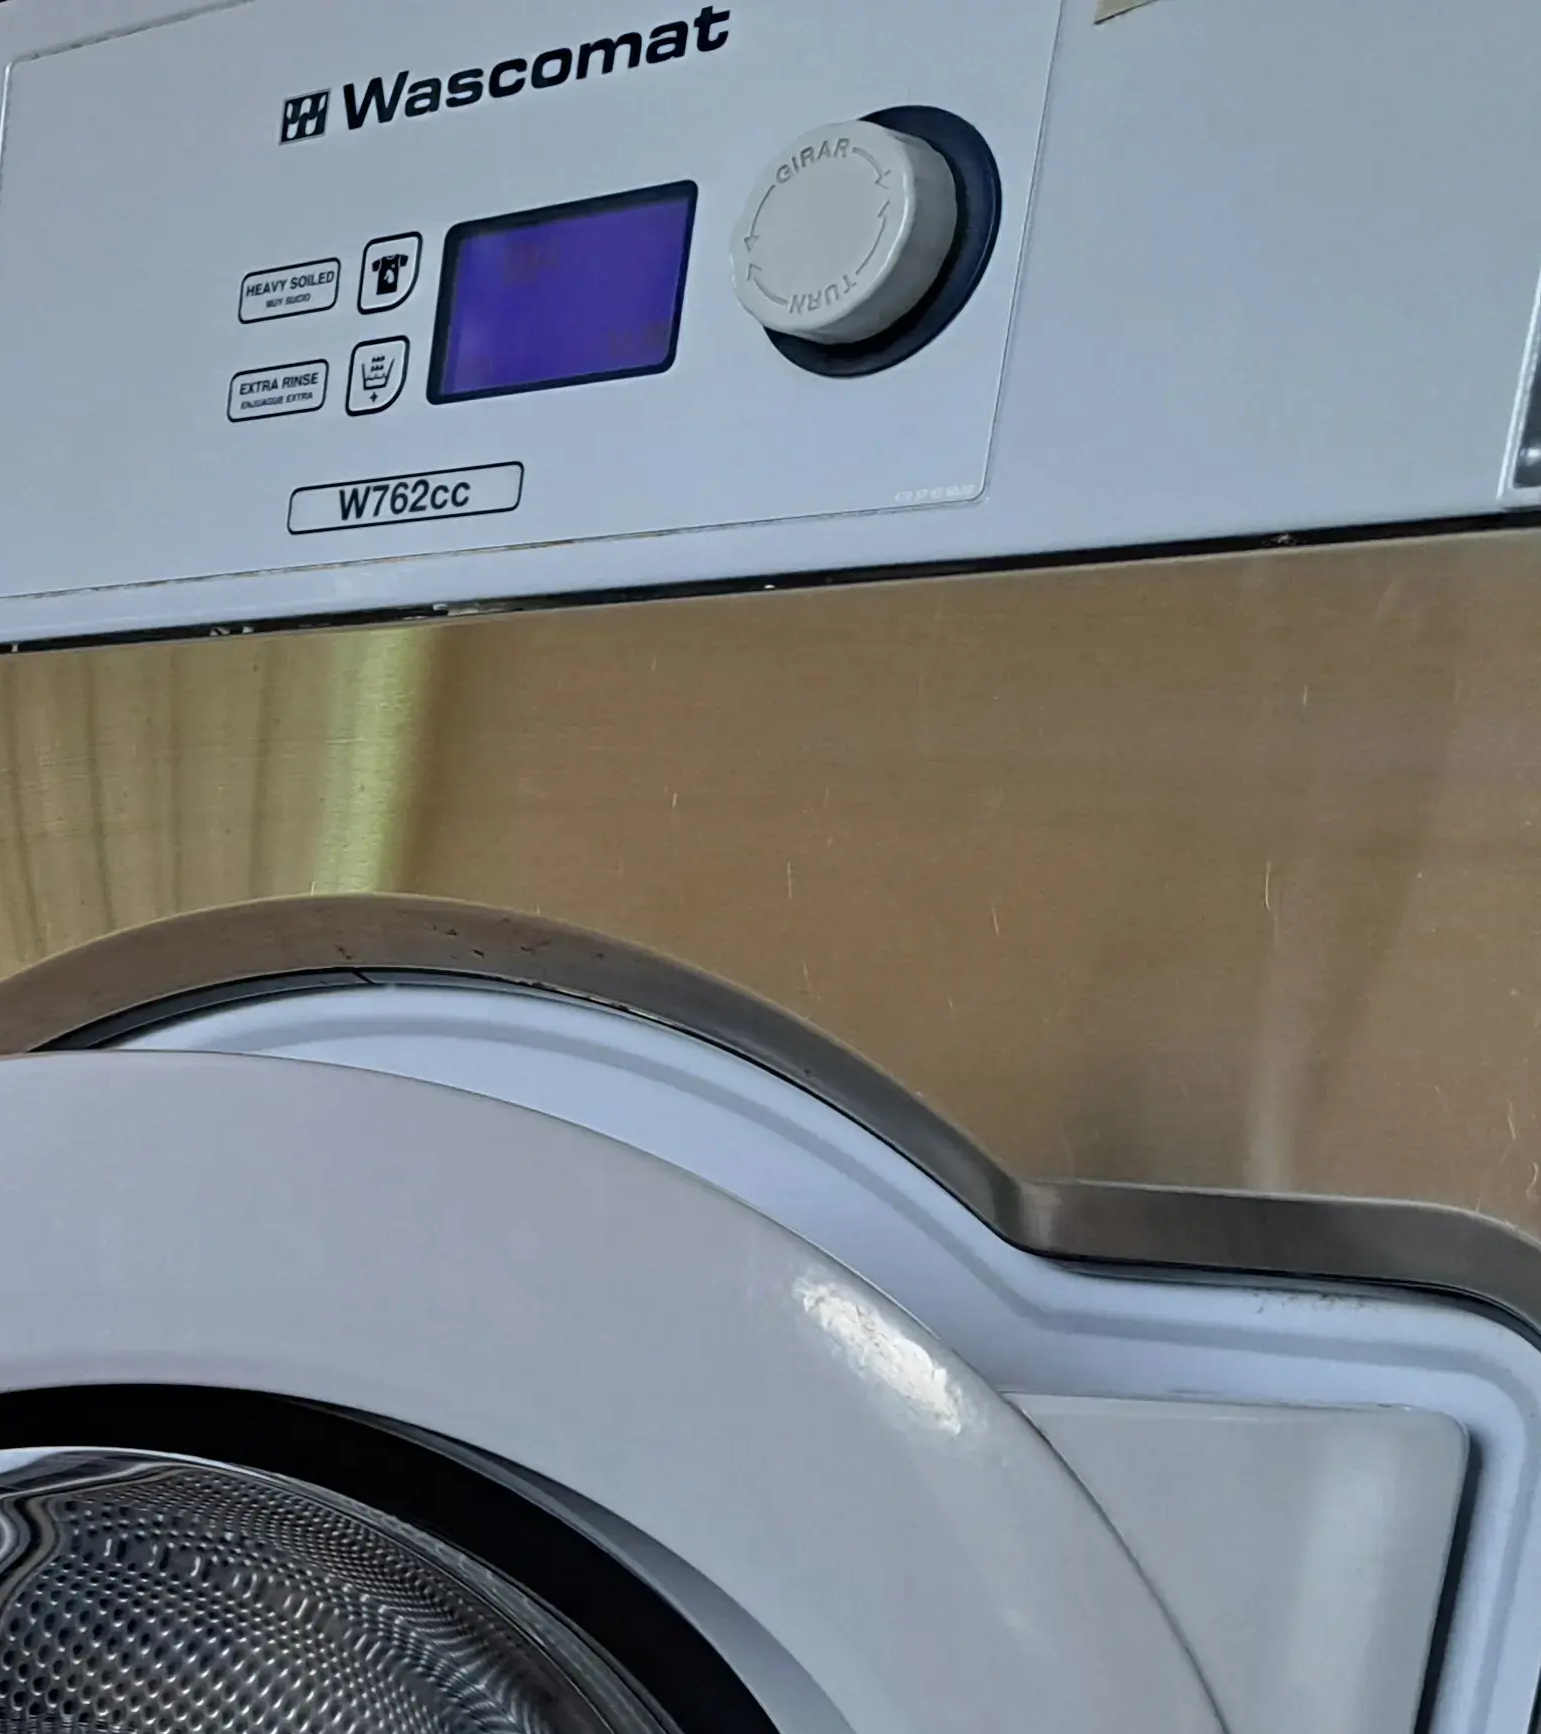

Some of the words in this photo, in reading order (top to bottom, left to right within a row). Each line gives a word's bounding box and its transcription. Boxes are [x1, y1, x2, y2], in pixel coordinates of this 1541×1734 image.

[343, 5, 730, 130] Wascomat
[775, 138, 851, 184] GIRAR
[245, 279, 287, 297] HEAVY
[290, 271, 335, 289] SOILED
[789, 274, 857, 315] TURN
[239, 378, 279, 395] EXTRA
[281, 372, 319, 389] RINSE
[339, 478, 471, 521] W762cc
